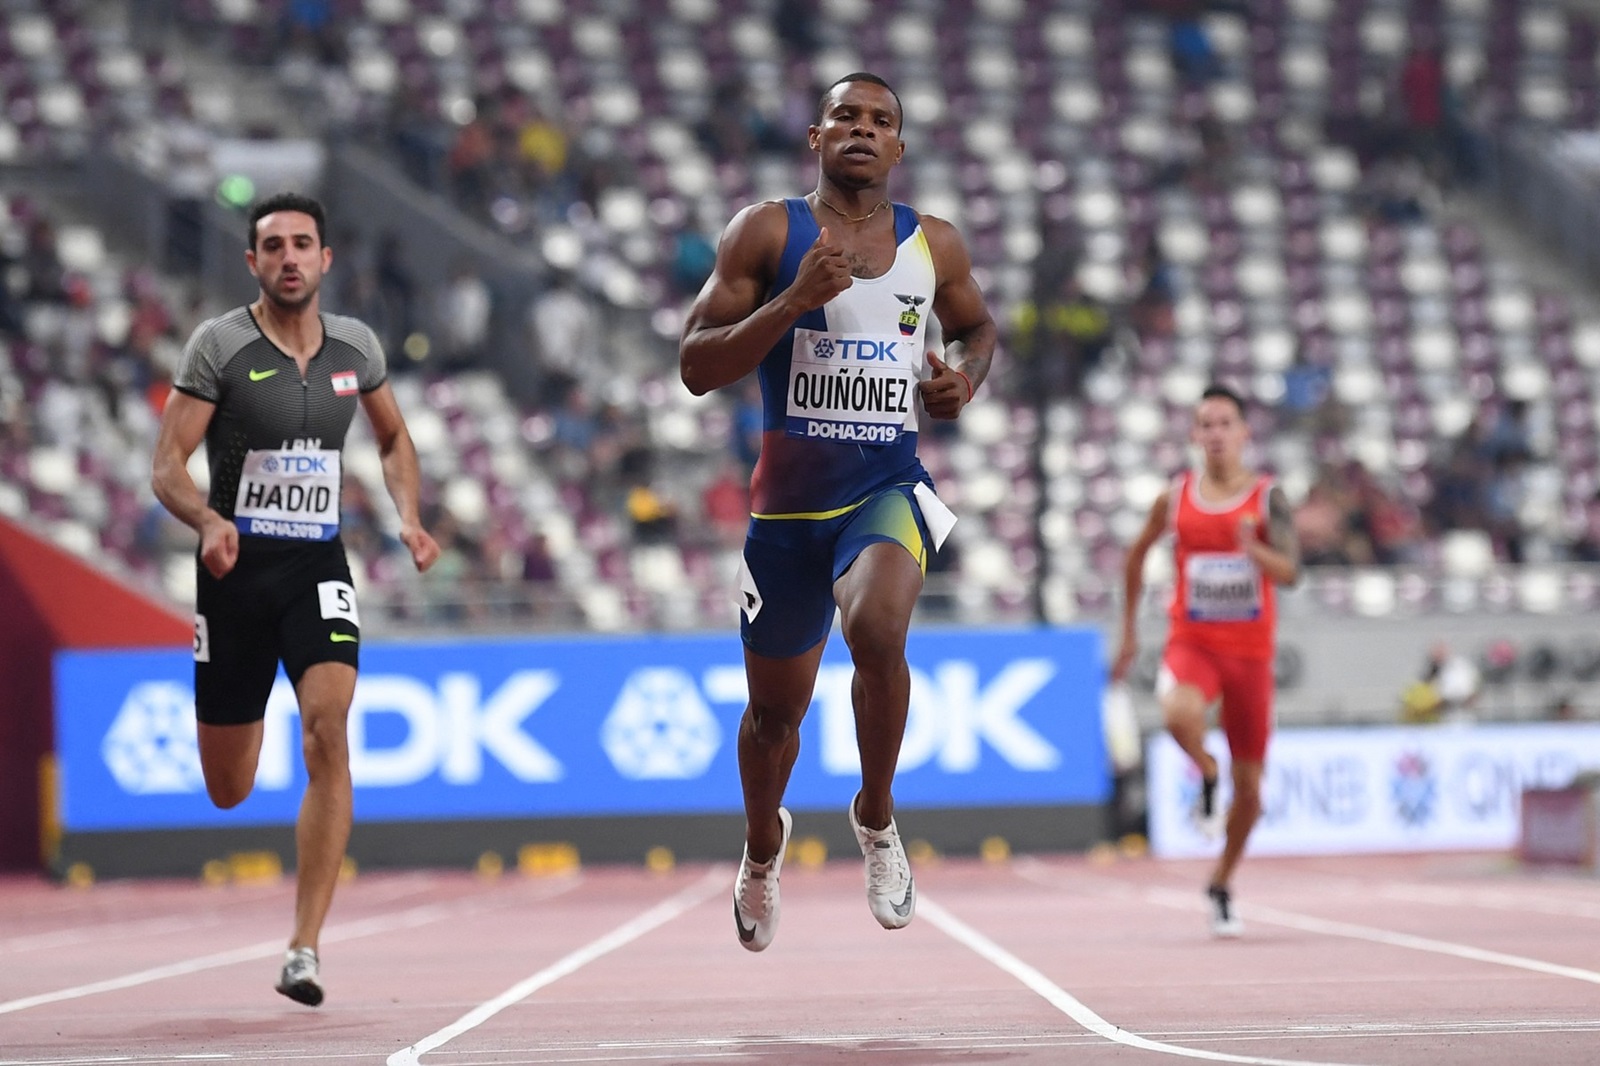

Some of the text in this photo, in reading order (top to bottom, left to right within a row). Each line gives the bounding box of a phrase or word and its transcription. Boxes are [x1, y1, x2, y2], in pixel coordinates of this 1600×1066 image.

[835, 339, 898, 362] TDK
[793, 368, 908, 413] QUIÑÓNEZ
[807, 421, 897, 442] DOHA2019
[281, 456, 327, 473] TDK
[244, 481, 330, 513] HADID
[337, 588, 350, 612] 5
